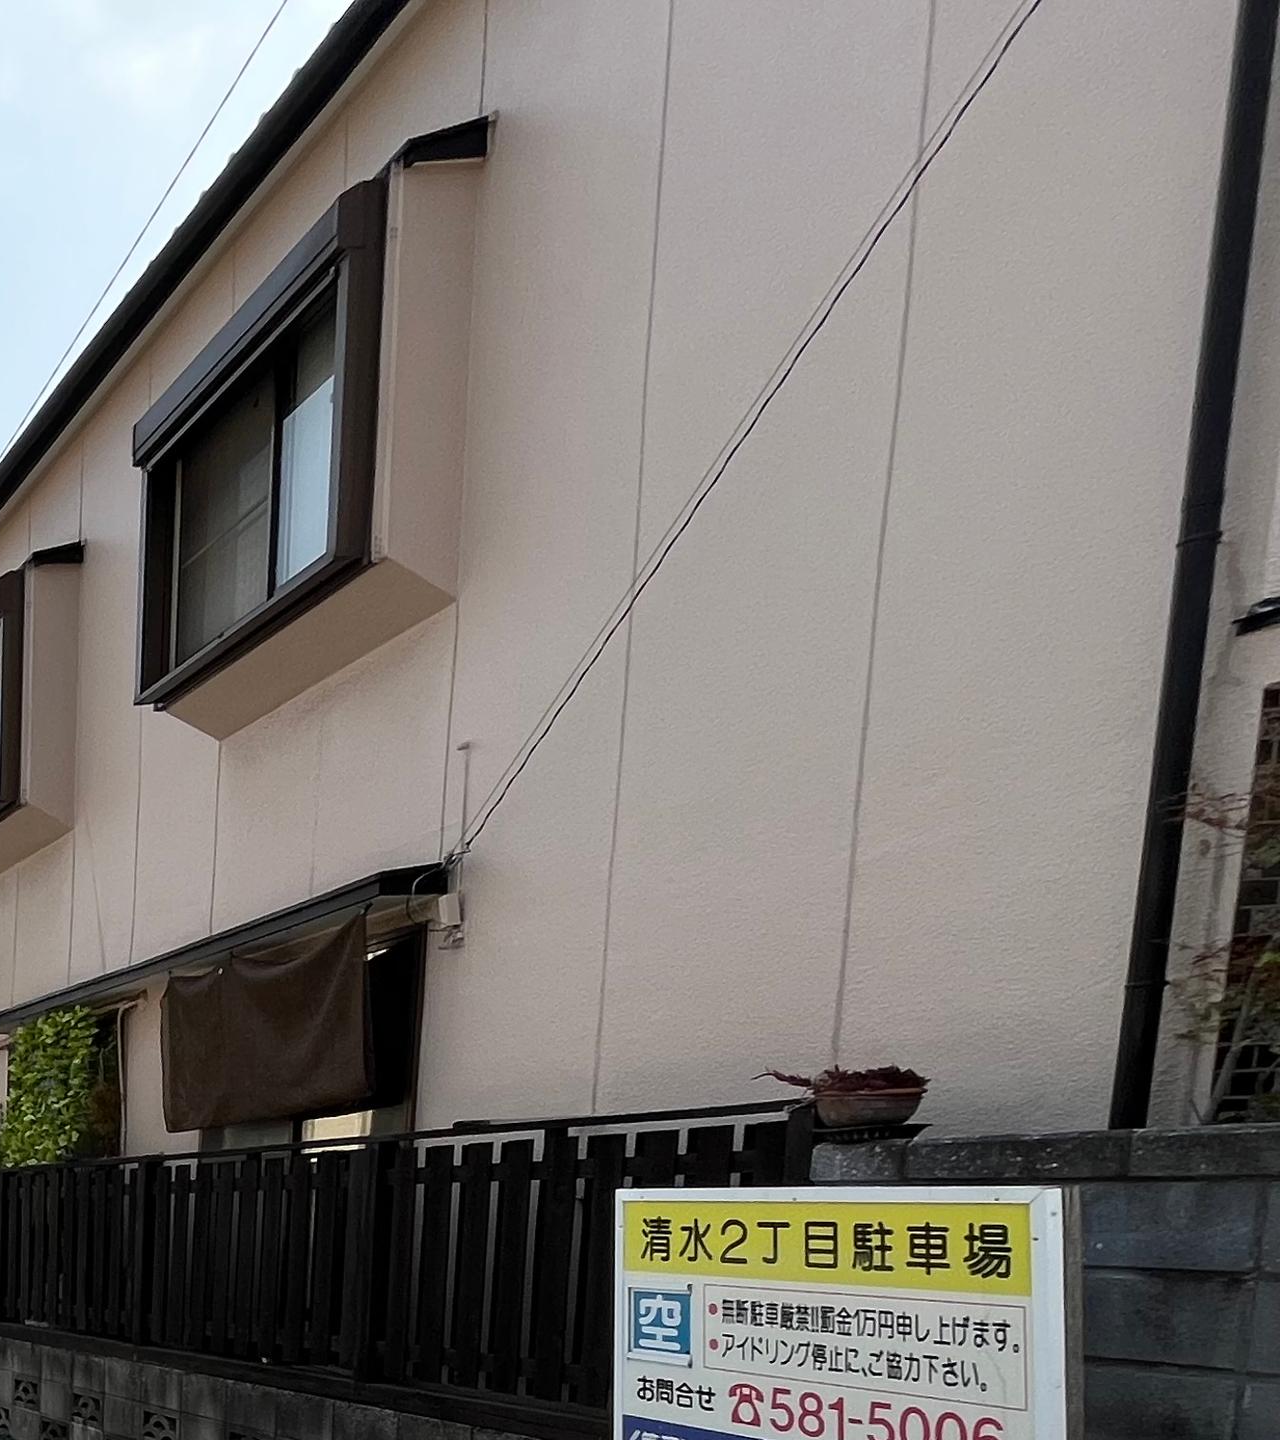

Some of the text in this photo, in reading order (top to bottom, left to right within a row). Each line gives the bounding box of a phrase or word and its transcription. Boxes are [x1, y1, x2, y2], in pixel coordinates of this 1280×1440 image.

[640, 1216, 1012, 1279] 清水2丁目駐車場
[638, 1294, 682, 1351] 空
[637, 1376, 716, 1411] お問合せ
